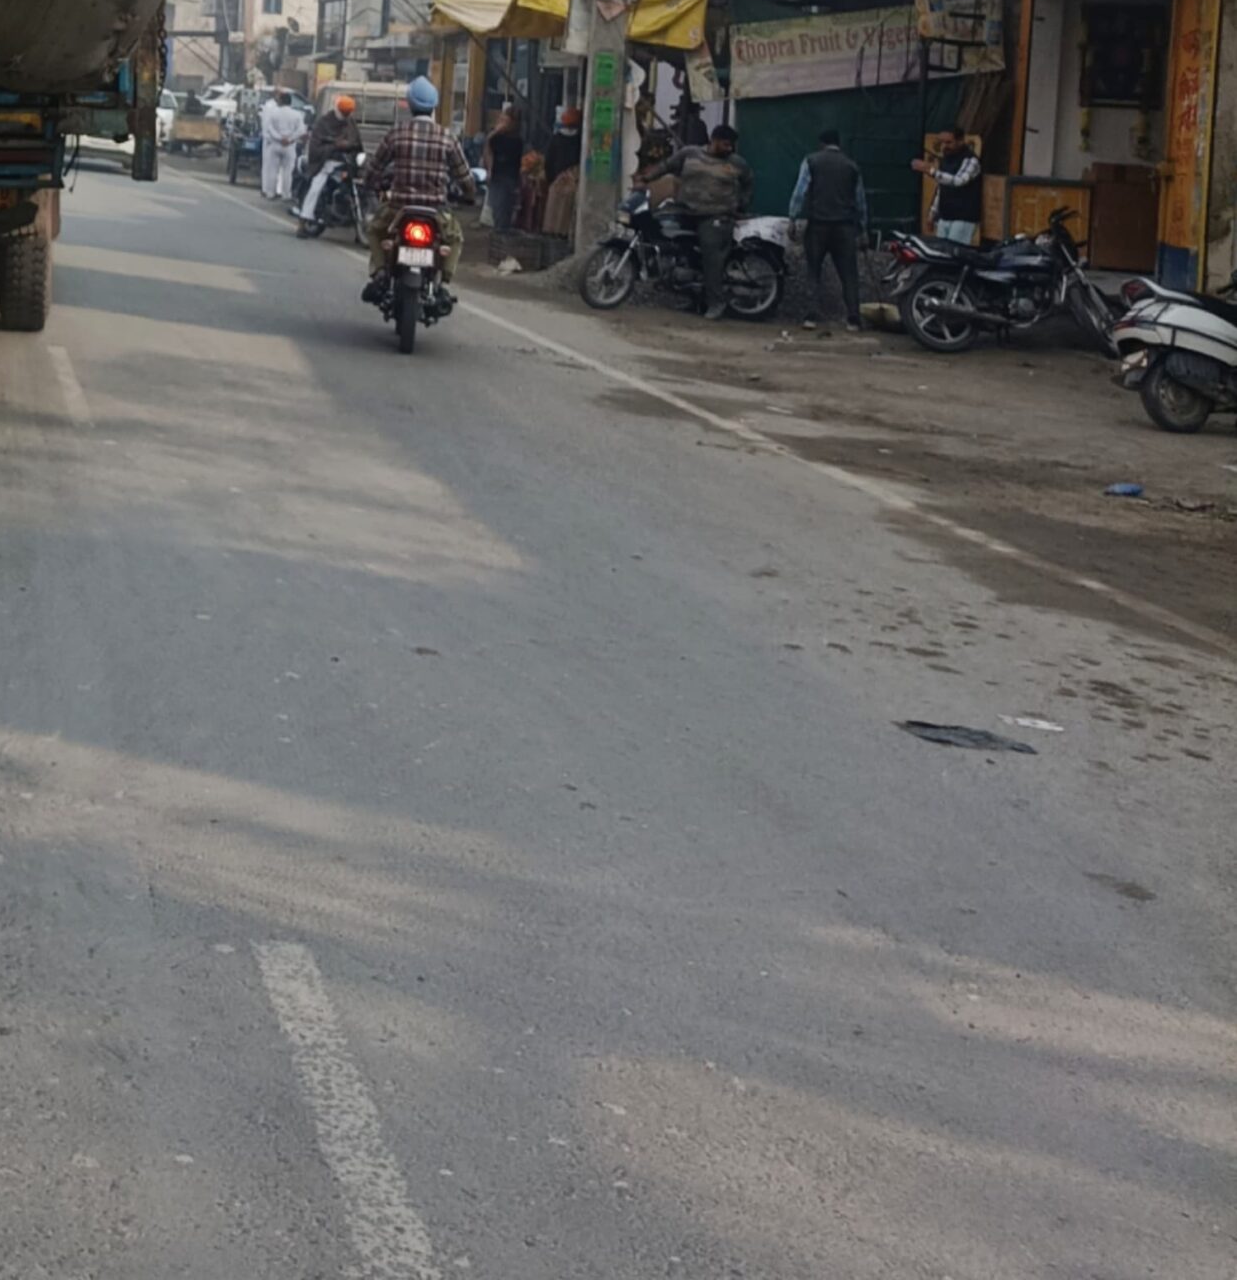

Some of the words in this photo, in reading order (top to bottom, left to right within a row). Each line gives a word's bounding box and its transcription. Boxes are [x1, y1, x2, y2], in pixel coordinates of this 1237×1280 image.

[734, 32, 796, 64] Chopra
[798, 29, 843, 59] Fruit
[845, 30, 858, 51] &
